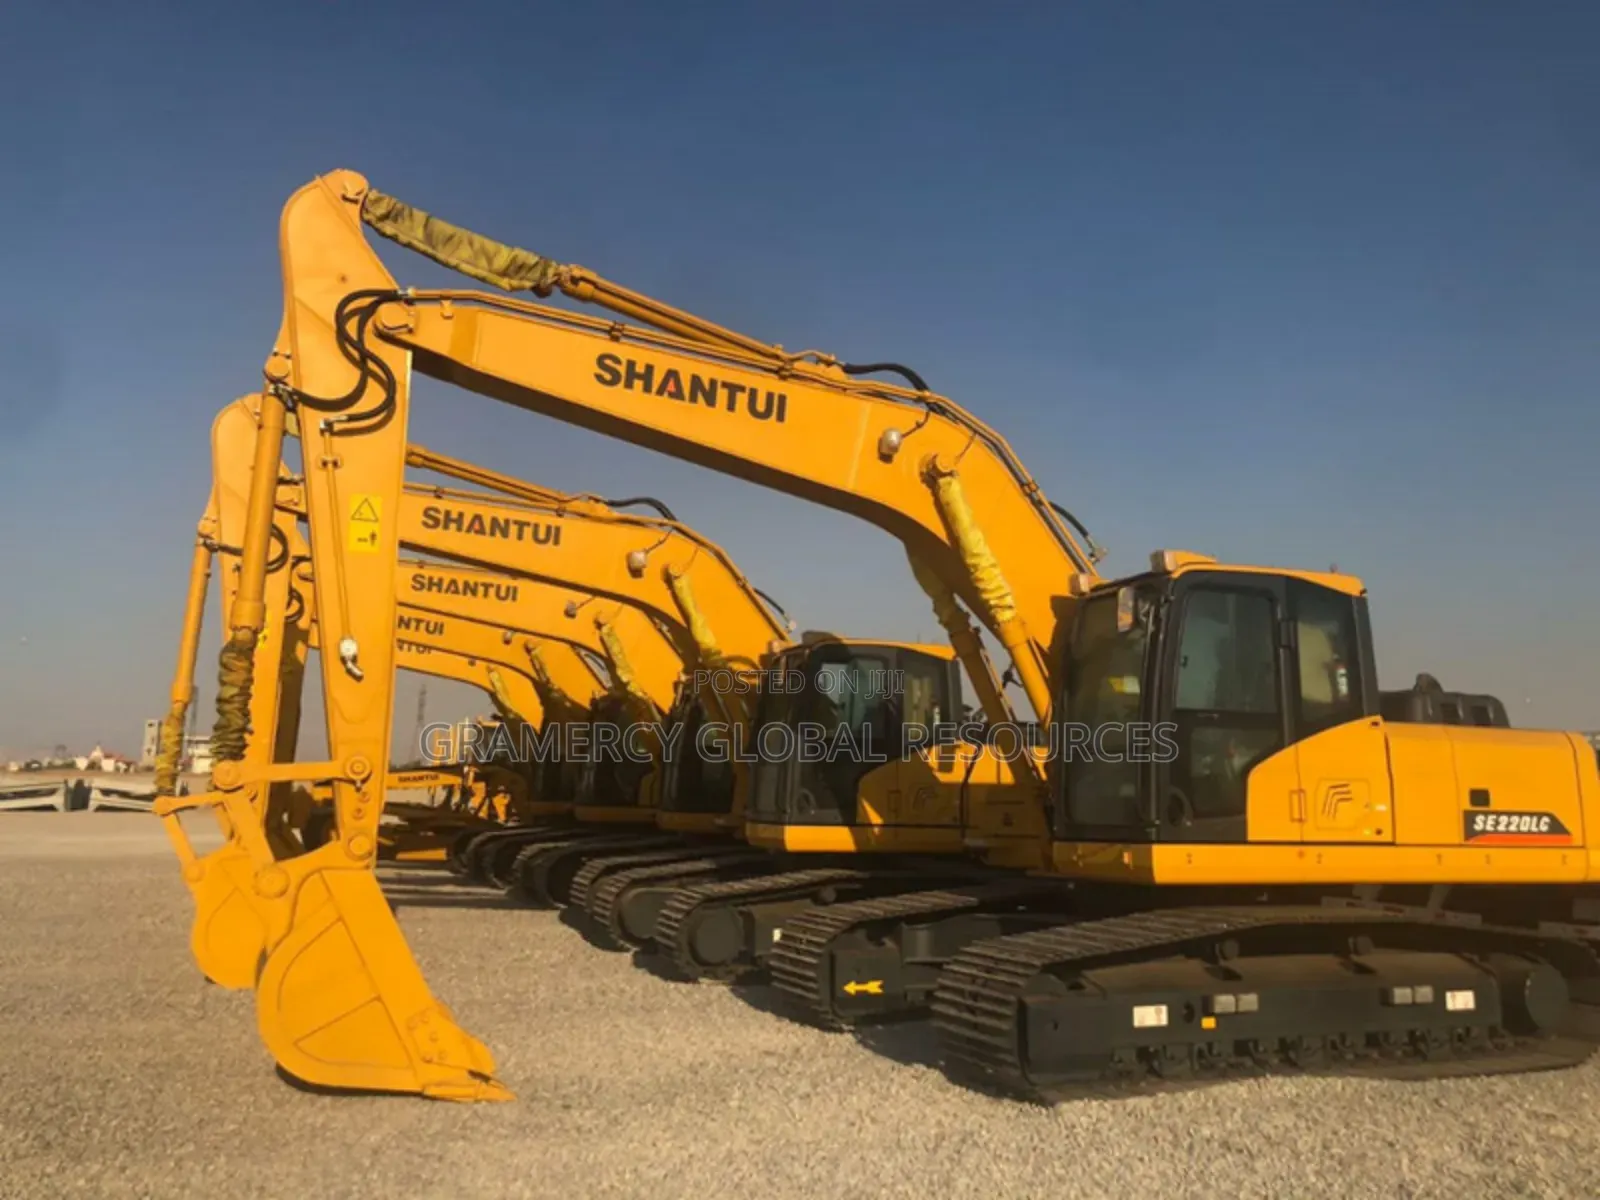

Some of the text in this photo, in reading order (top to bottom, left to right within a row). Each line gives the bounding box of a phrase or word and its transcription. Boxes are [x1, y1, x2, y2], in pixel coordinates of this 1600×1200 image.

[594, 353, 788, 423] SHANTUI
[421, 506, 562, 547] SHANTUI
[410, 573, 519, 602] SHANTUI
[397, 615, 445, 636] NTUI
[1473, 814, 1551, 832] SE220LC
